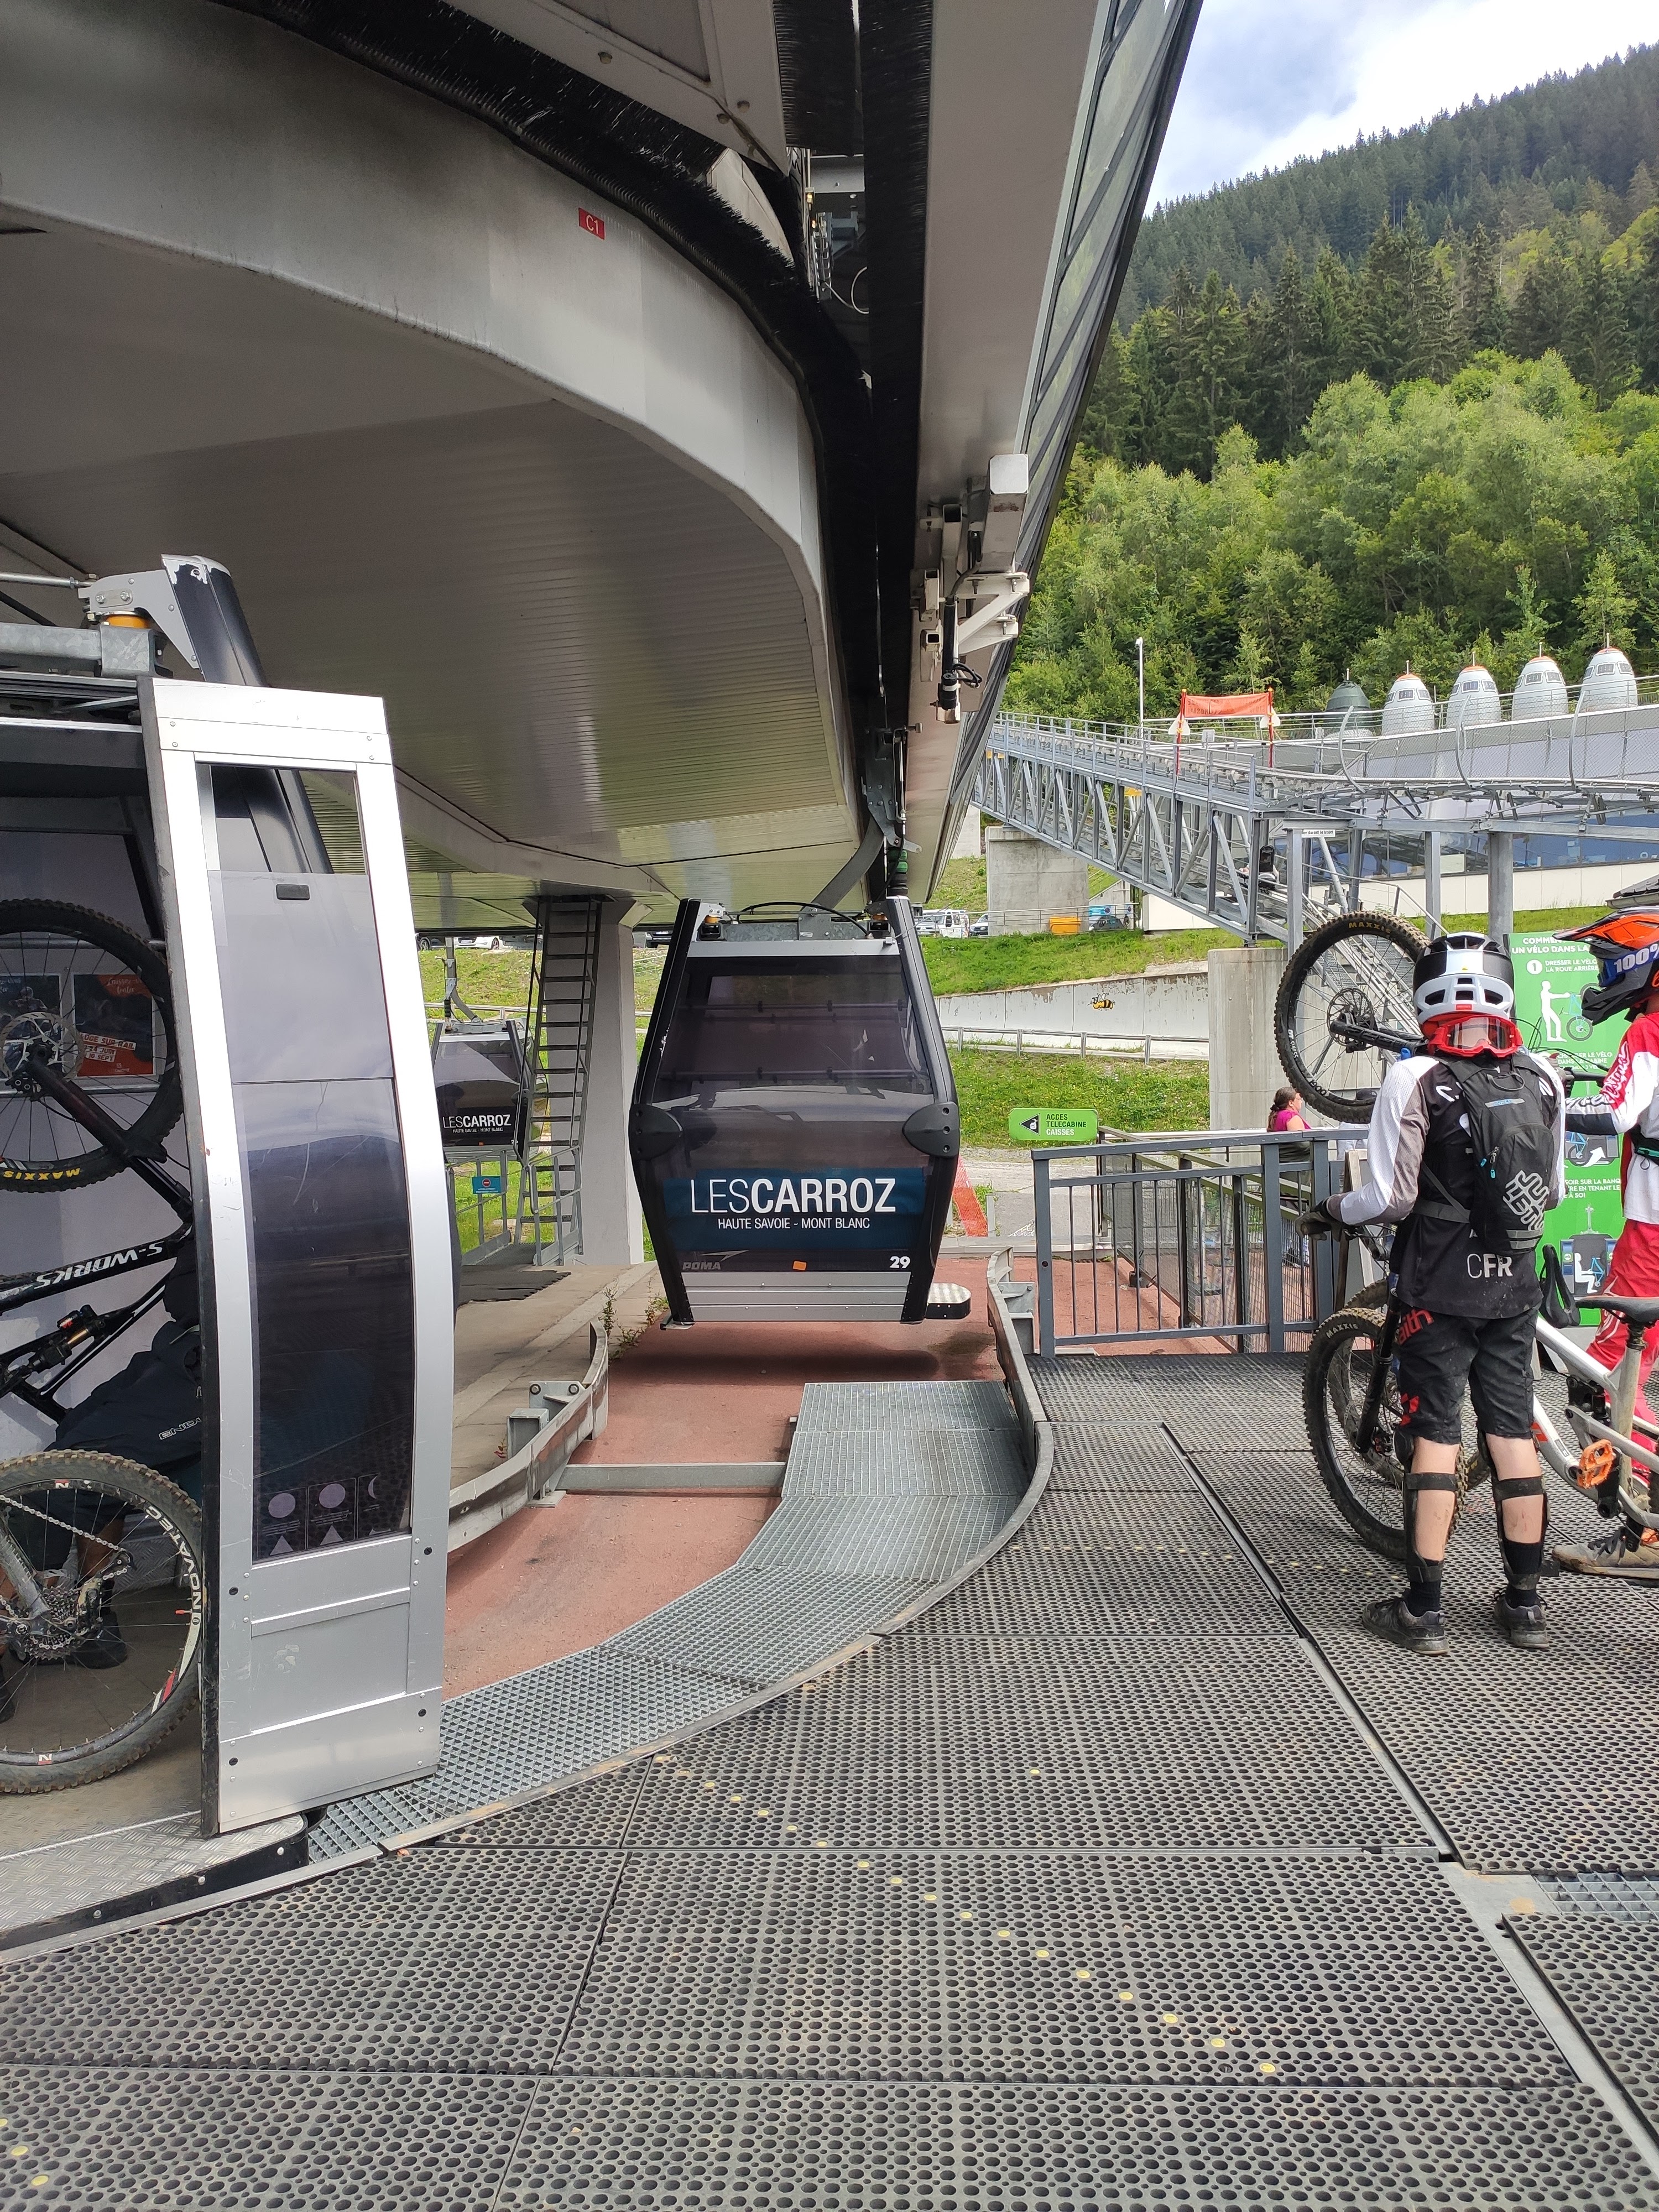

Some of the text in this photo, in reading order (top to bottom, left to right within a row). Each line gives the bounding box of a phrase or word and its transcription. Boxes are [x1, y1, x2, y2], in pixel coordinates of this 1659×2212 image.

[586, 215, 598, 234] C1
[1348, 922, 1391, 933] MAXXIS
[1527, 945, 1550, 953] VÉLO
[3, 1167, 80, 1181] MAXXIS
[718, 1218, 752, 1229] HAUTE
[754, 1218, 790, 1229] SAVOIE
[801, 1218, 832, 1229] MONT
[835, 1218, 870, 1229] BLANC
[34, 1240, 164, 1290] S-WORKS
[682, 1262, 722, 1270] POMA
[889, 1256, 911, 1269] 29
[1467, 1254, 1513, 1279] CFR
[1326, 1322, 1358, 1339] MAXXIS
[146, 1506, 201, 1613] NOVATEC
